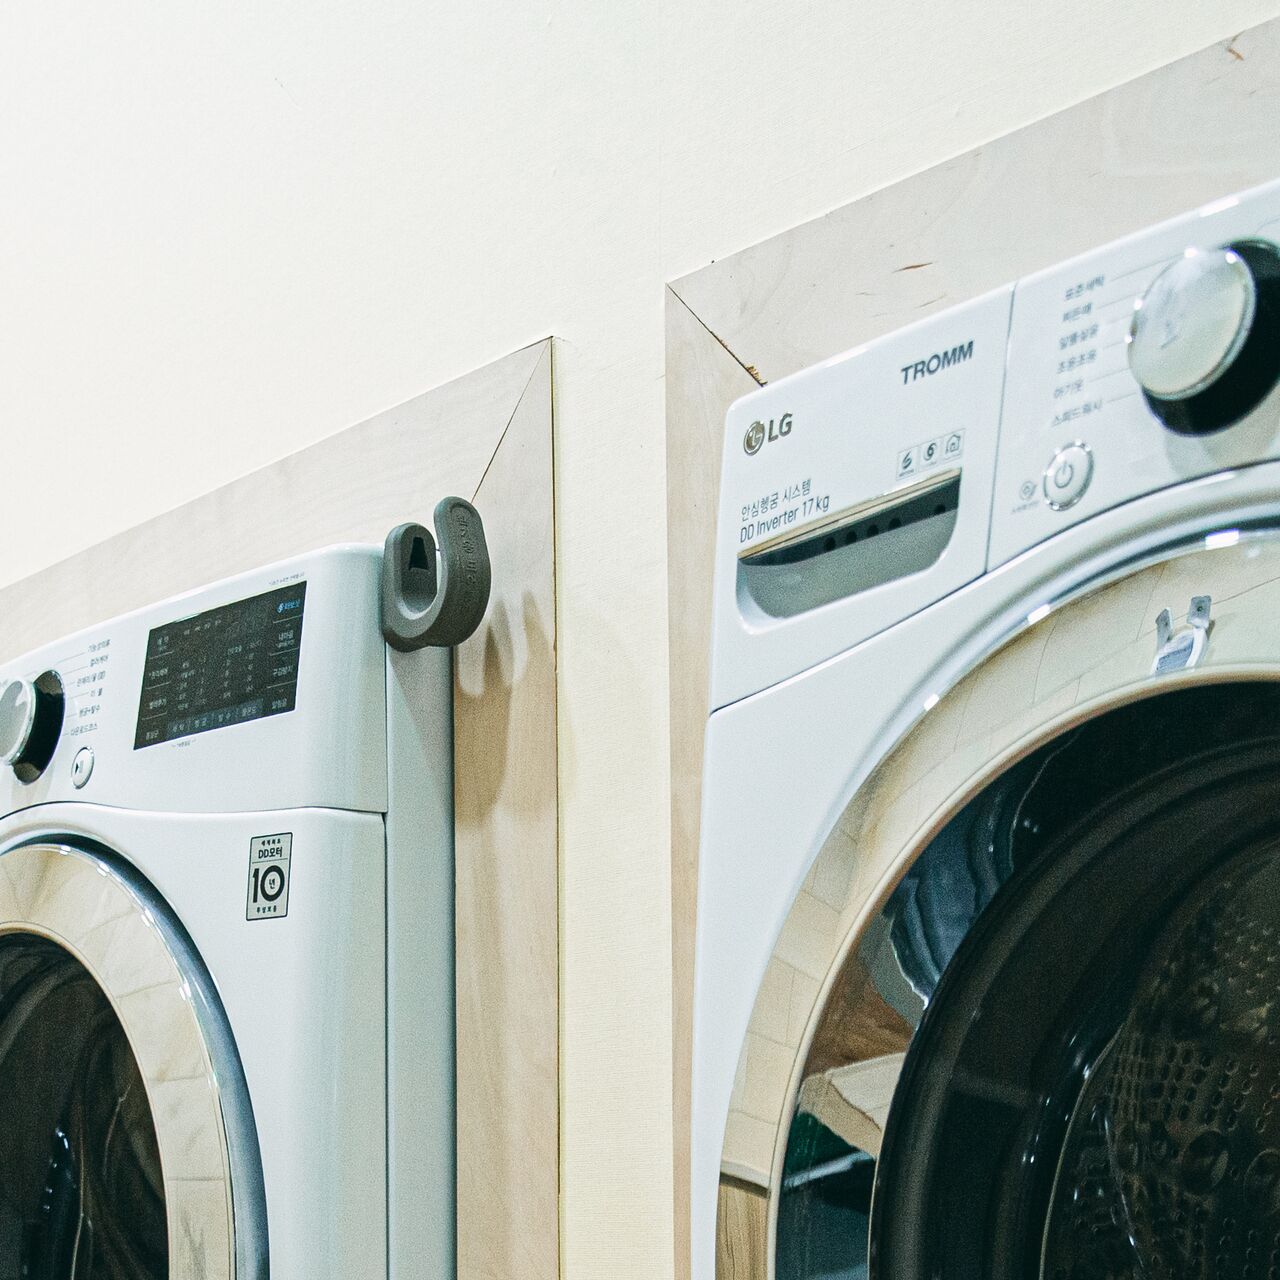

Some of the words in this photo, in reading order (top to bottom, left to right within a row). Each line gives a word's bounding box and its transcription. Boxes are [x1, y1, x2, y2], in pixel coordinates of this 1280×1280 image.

[901, 340, 974, 385] TROMM
[768, 412, 793, 443] LG
[741, 492, 779, 522] 안심헹굼
[783, 478, 812, 502] 시스템
[740, 523, 755, 543] DD
[757, 507, 799, 536] Inverter
[258, 847, 283, 859] DD모터
[252, 865, 285, 903] 10
